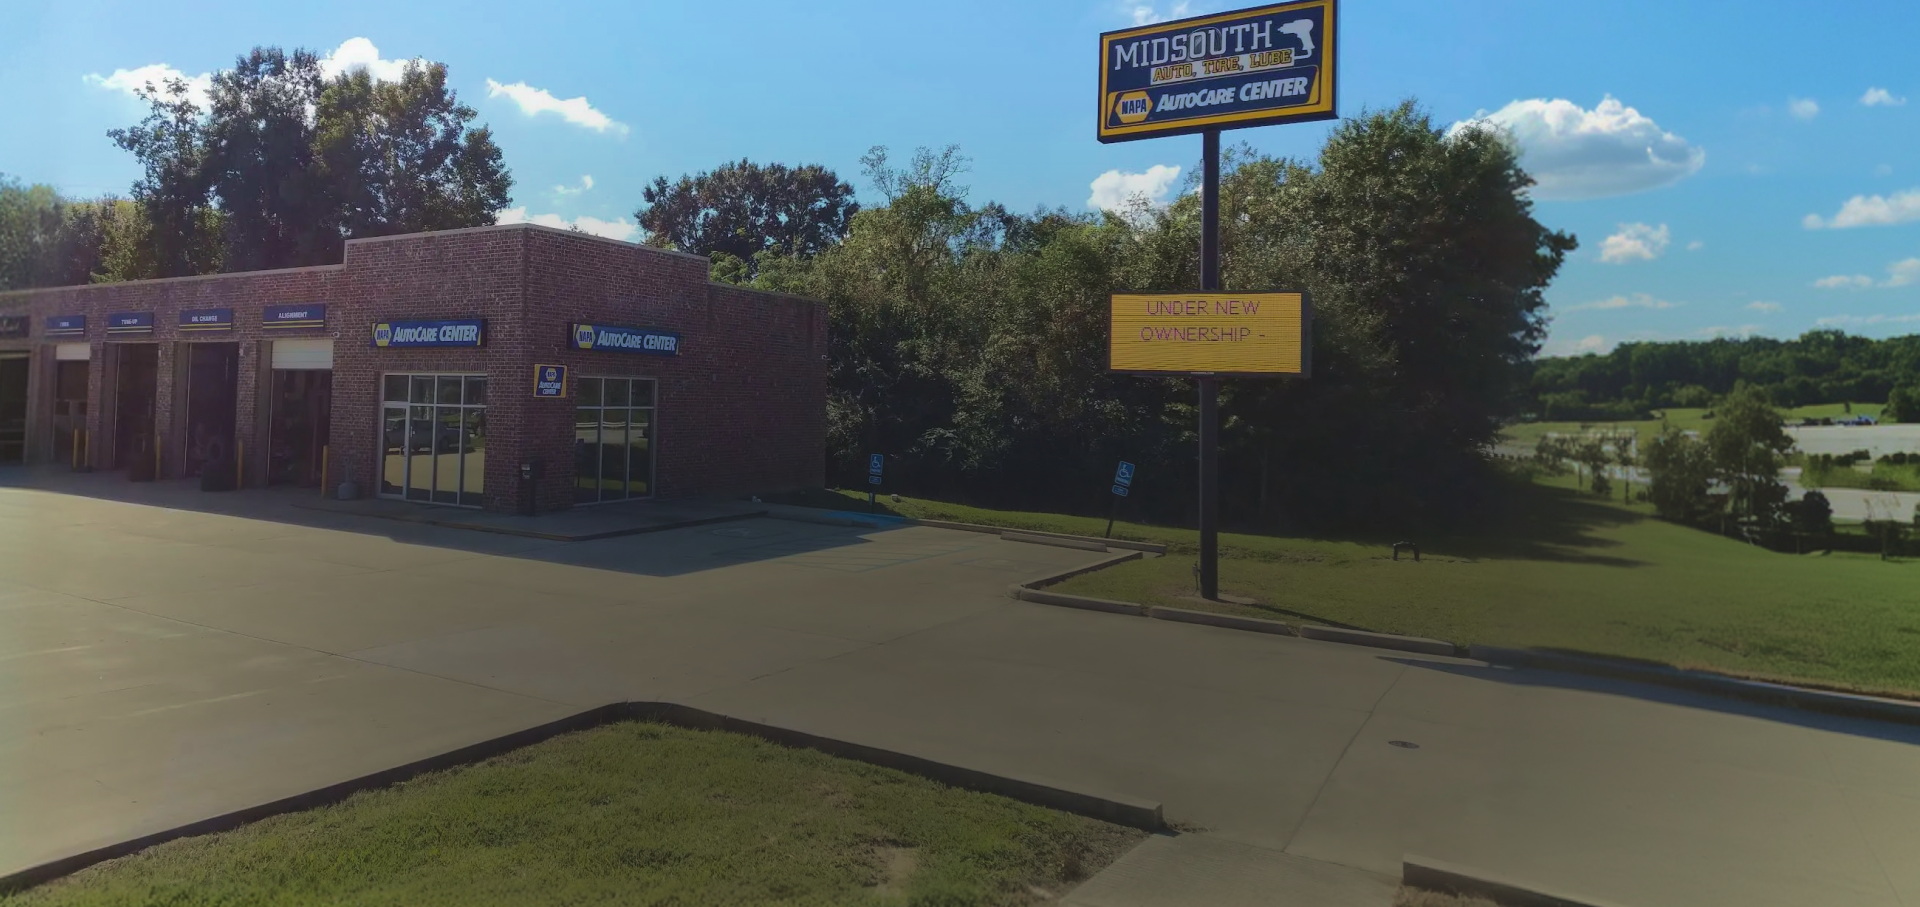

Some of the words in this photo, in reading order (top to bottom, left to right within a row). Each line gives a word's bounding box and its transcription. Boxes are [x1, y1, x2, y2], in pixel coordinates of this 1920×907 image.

[1115, 20, 1272, 70] MIDSOUTH
[1153, 63, 1197, 82] AUTO,
[1203, 57, 1244, 75] TIRE,
[1250, 49, 1293, 68] LUBE
[1240, 77, 1308, 102] CENTER
[1121, 98, 1147, 114] NAPA
[278, 311, 308, 319] ALIGNMENT
[1147, 301, 1209, 315] UNDER
[1216, 301, 1260, 315] NEW
[439, 325, 478, 342] CENTER
[579, 330, 593, 343] NAPA
[1140, 327, 1250, 342] OWNERSHIP
[643, 334, 677, 351] CENTER
